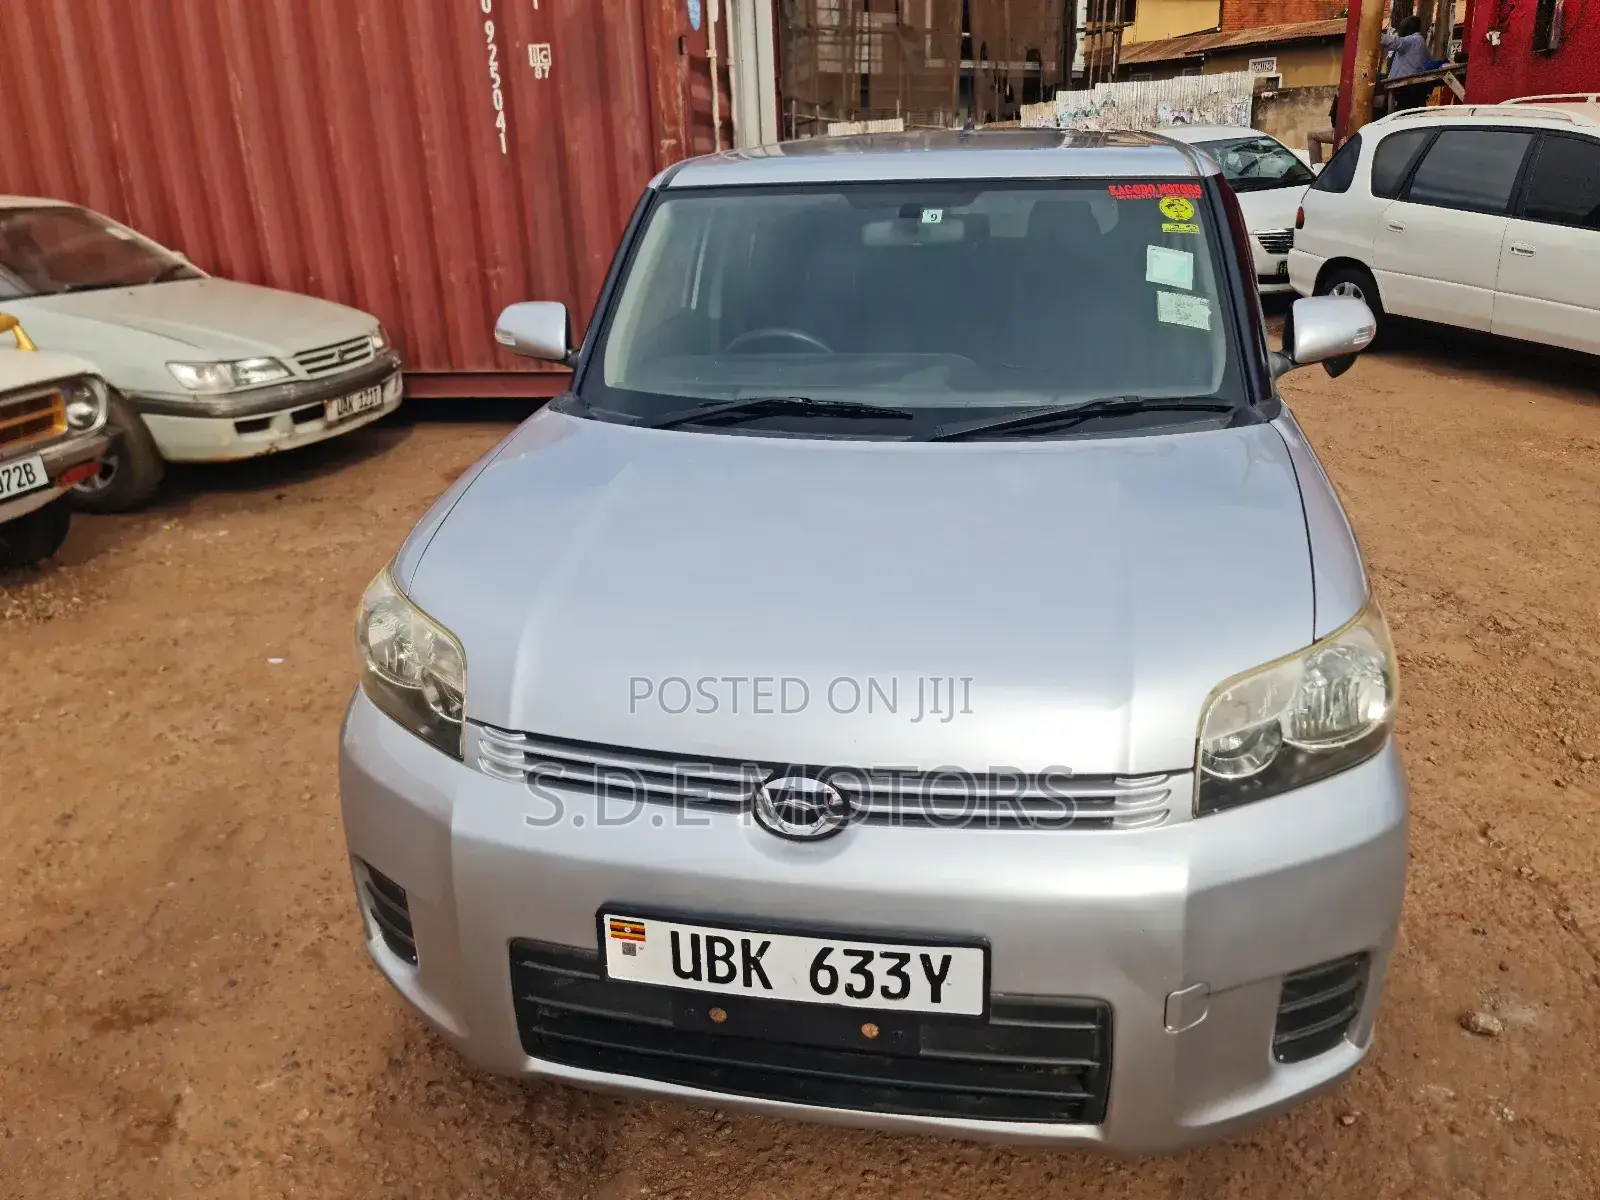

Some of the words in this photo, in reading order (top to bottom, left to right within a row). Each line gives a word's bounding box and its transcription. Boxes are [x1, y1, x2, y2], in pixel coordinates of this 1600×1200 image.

[1156, 184, 1203, 196] MOTORS
[670, 930, 773, 990] UBK
[809, 946, 952, 1004] 633Y
